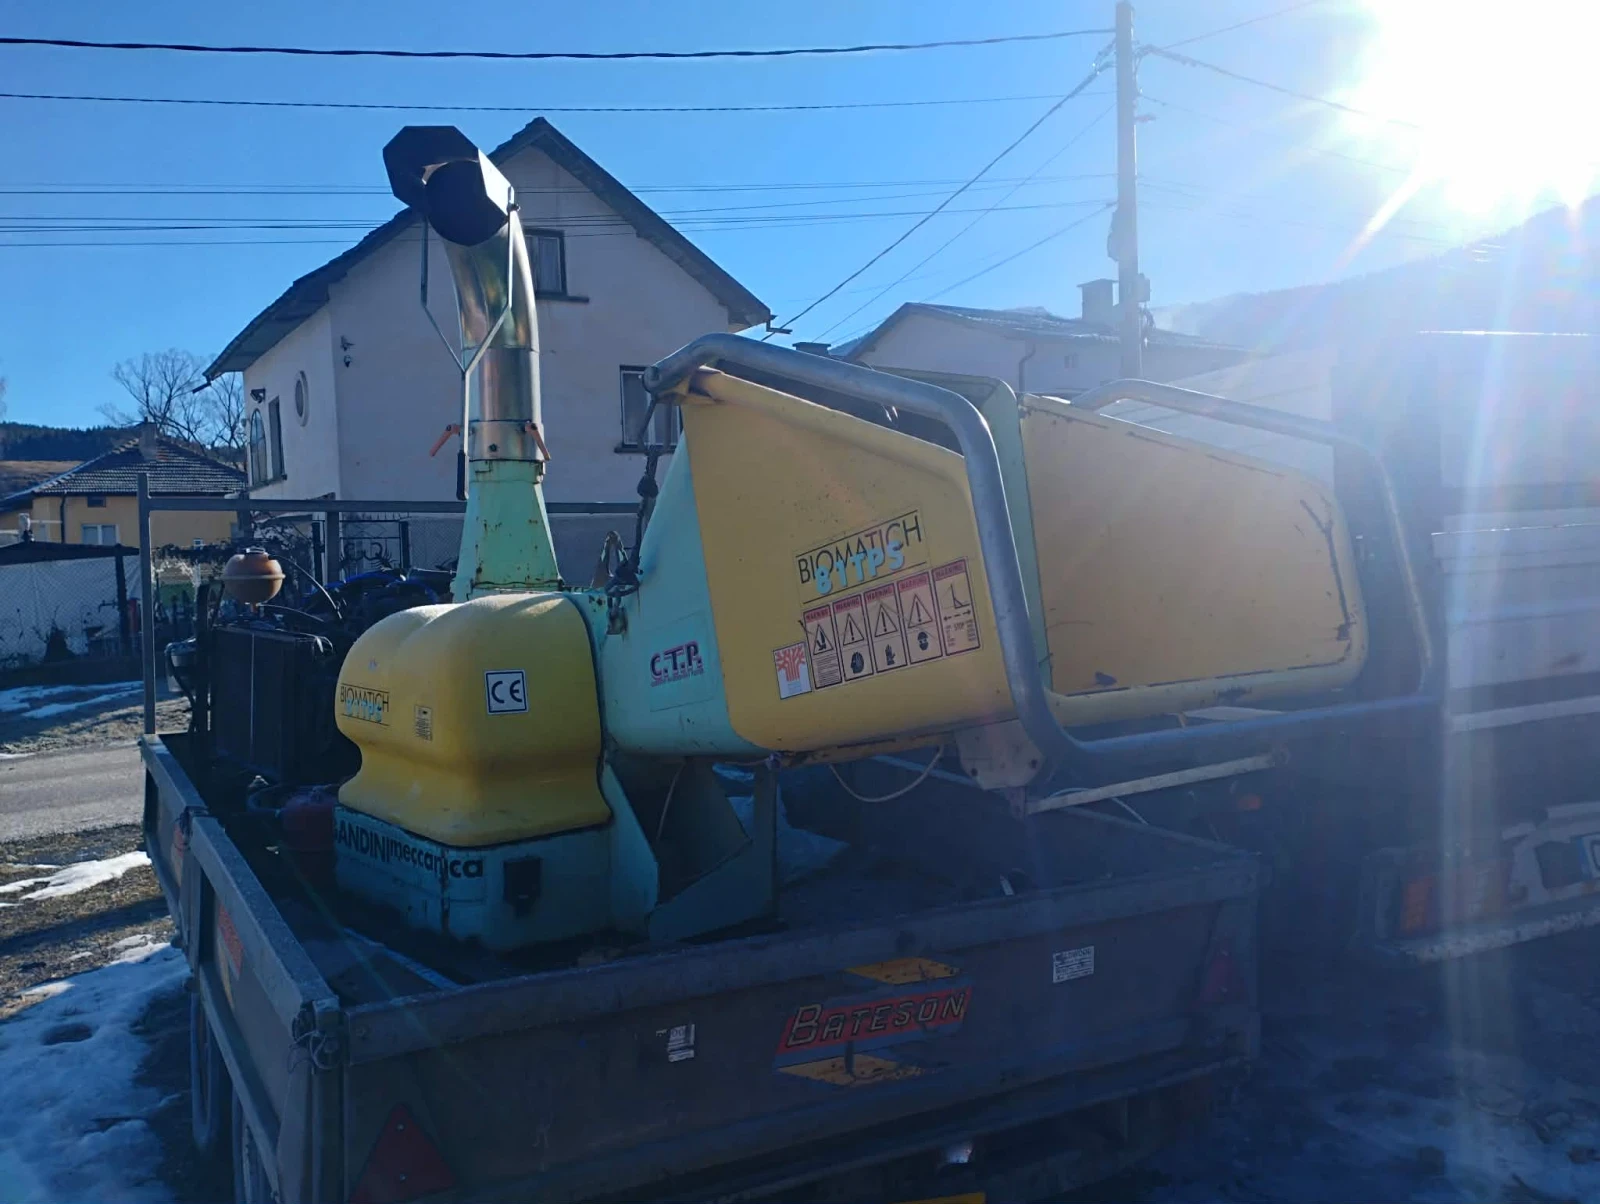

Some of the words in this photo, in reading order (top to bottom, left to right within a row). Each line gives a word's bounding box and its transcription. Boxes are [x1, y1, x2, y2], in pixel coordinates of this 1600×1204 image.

[935, 563, 964, 579] WARNING
[900, 574, 928, 591] WARNING
[865, 586, 893, 602] WARNING
[835, 597, 860, 613] WARNING
[491, 679, 523, 704] CE
[785, 991, 966, 1048] BATESON
